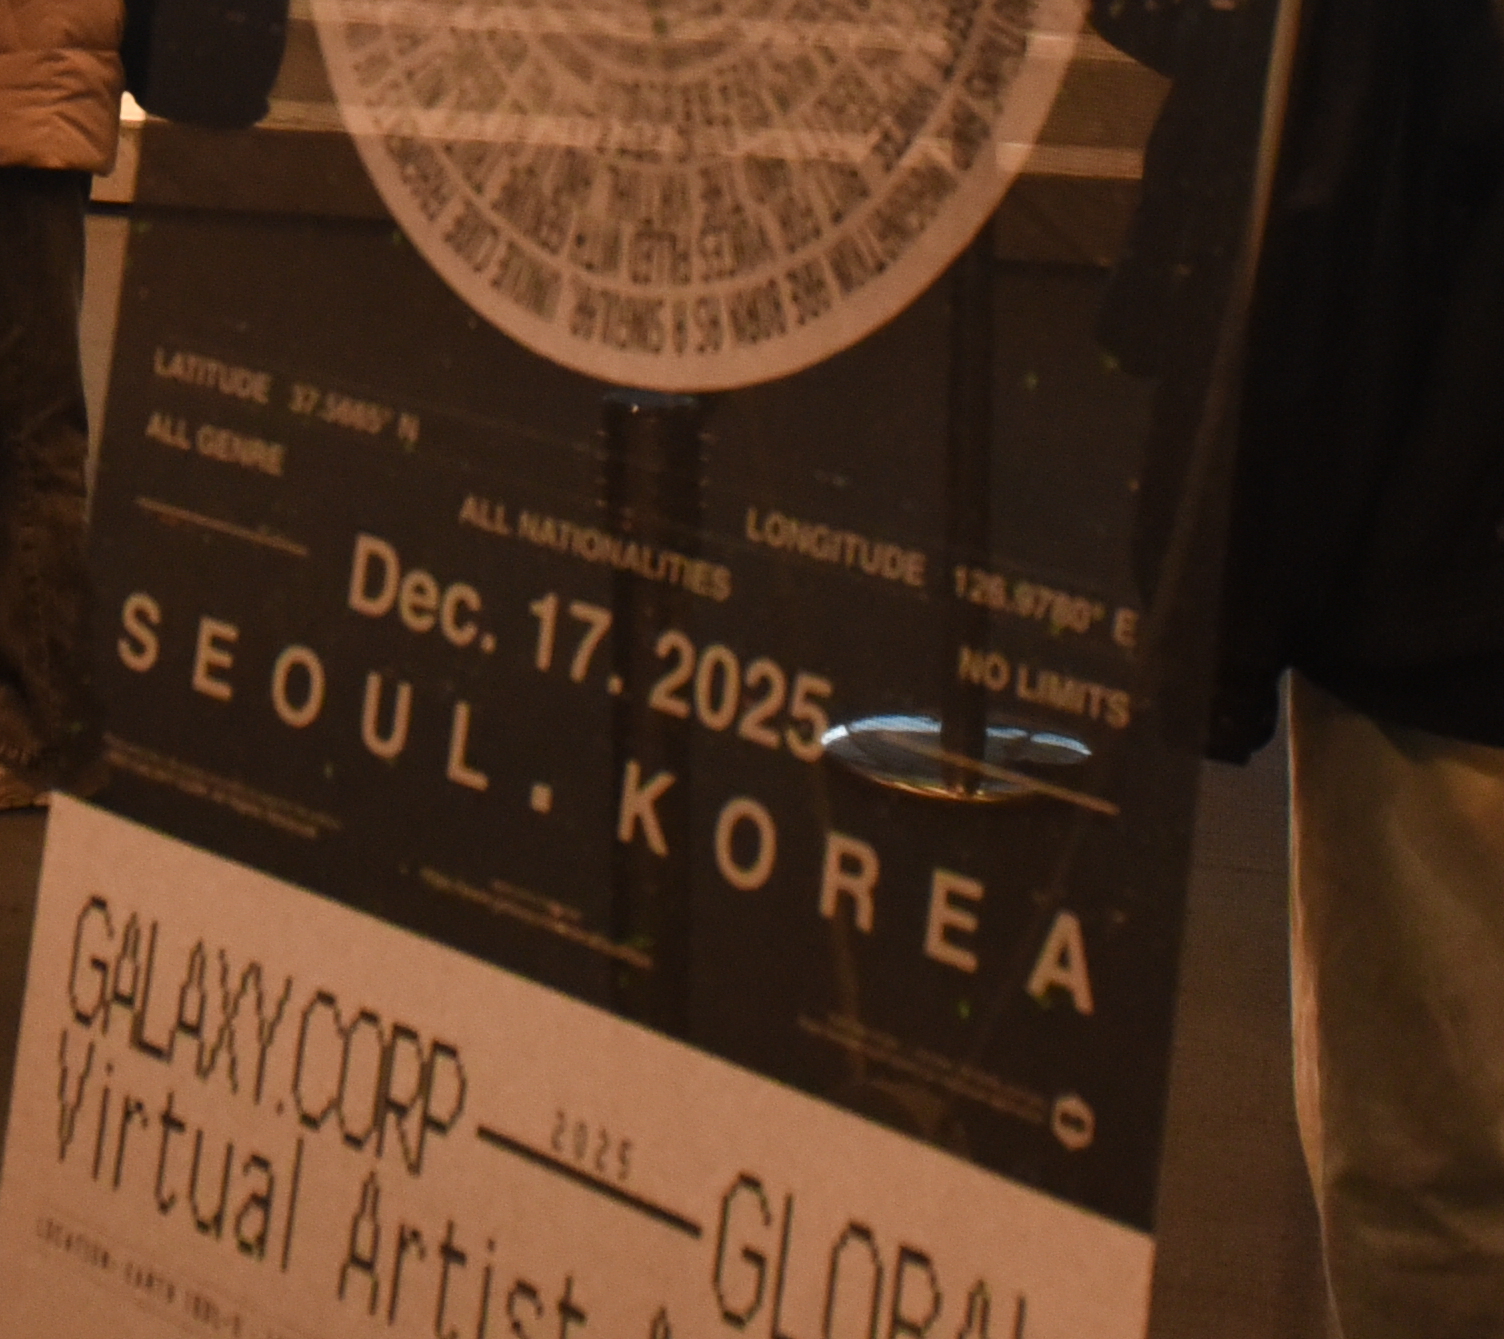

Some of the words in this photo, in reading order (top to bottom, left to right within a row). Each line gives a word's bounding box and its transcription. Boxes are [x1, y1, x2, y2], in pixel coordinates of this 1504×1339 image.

[145, 410, 191, 451] ALL
[154, 347, 272, 405] LATITUDE
[397, 412, 420, 444] N
[459, 492, 510, 537] ALL
[516, 509, 733, 603] NATIONALITIES
[745, 505, 928, 589] LONGITUDE
[1112, 607, 1141, 648] E
[347, 533, 496, 654] Dec.
[529, 591, 624, 697] 17.
[647, 627, 834, 764] 2025
[957, 644, 1012, 693] NO
[1016, 663, 1132, 731] LIMITS
[616, 759, 1098, 1017] KOREA
[67, 894, 468, 1179] GALAXY.CORP
[56, 1026, 305, 1274] Virtual
